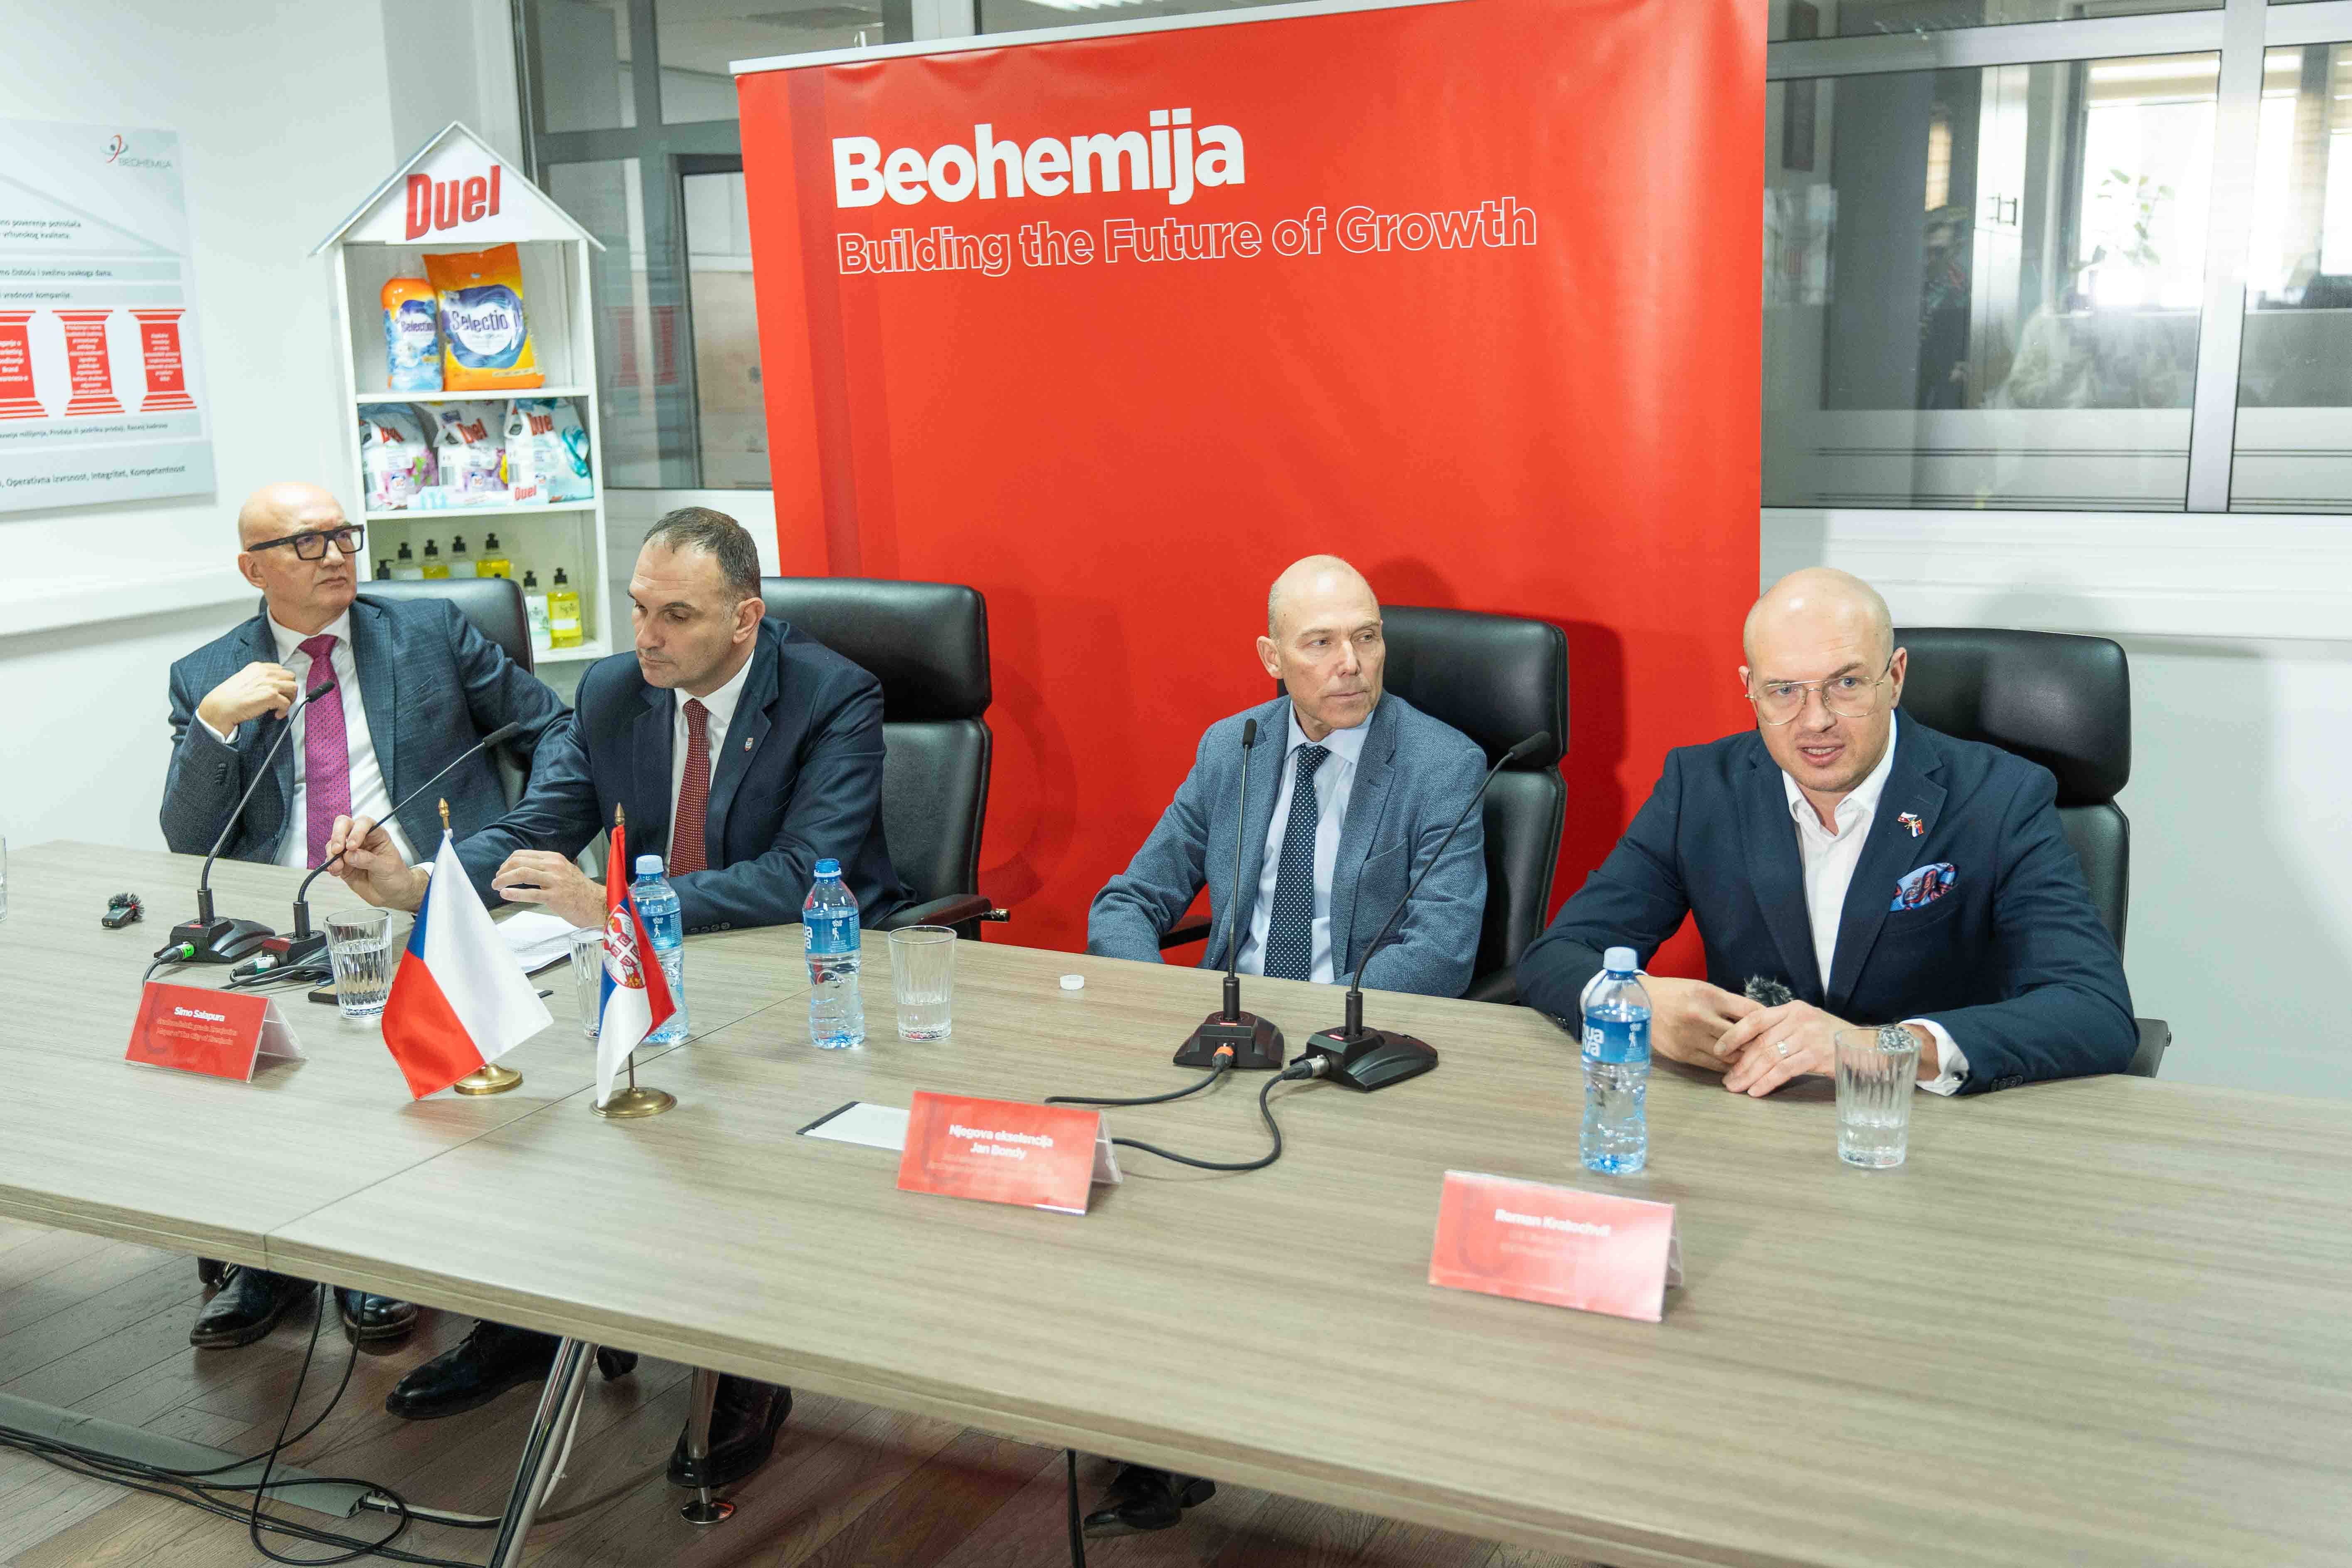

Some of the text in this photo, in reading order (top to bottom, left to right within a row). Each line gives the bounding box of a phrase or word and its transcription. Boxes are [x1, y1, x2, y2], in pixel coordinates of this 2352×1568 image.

[832, 107, 1245, 209] Beohemija
[405, 165, 501, 241] Duel
[837, 196, 1537, 277] Building the Future of Growth
[174, 1007, 193, 1017] Simo
